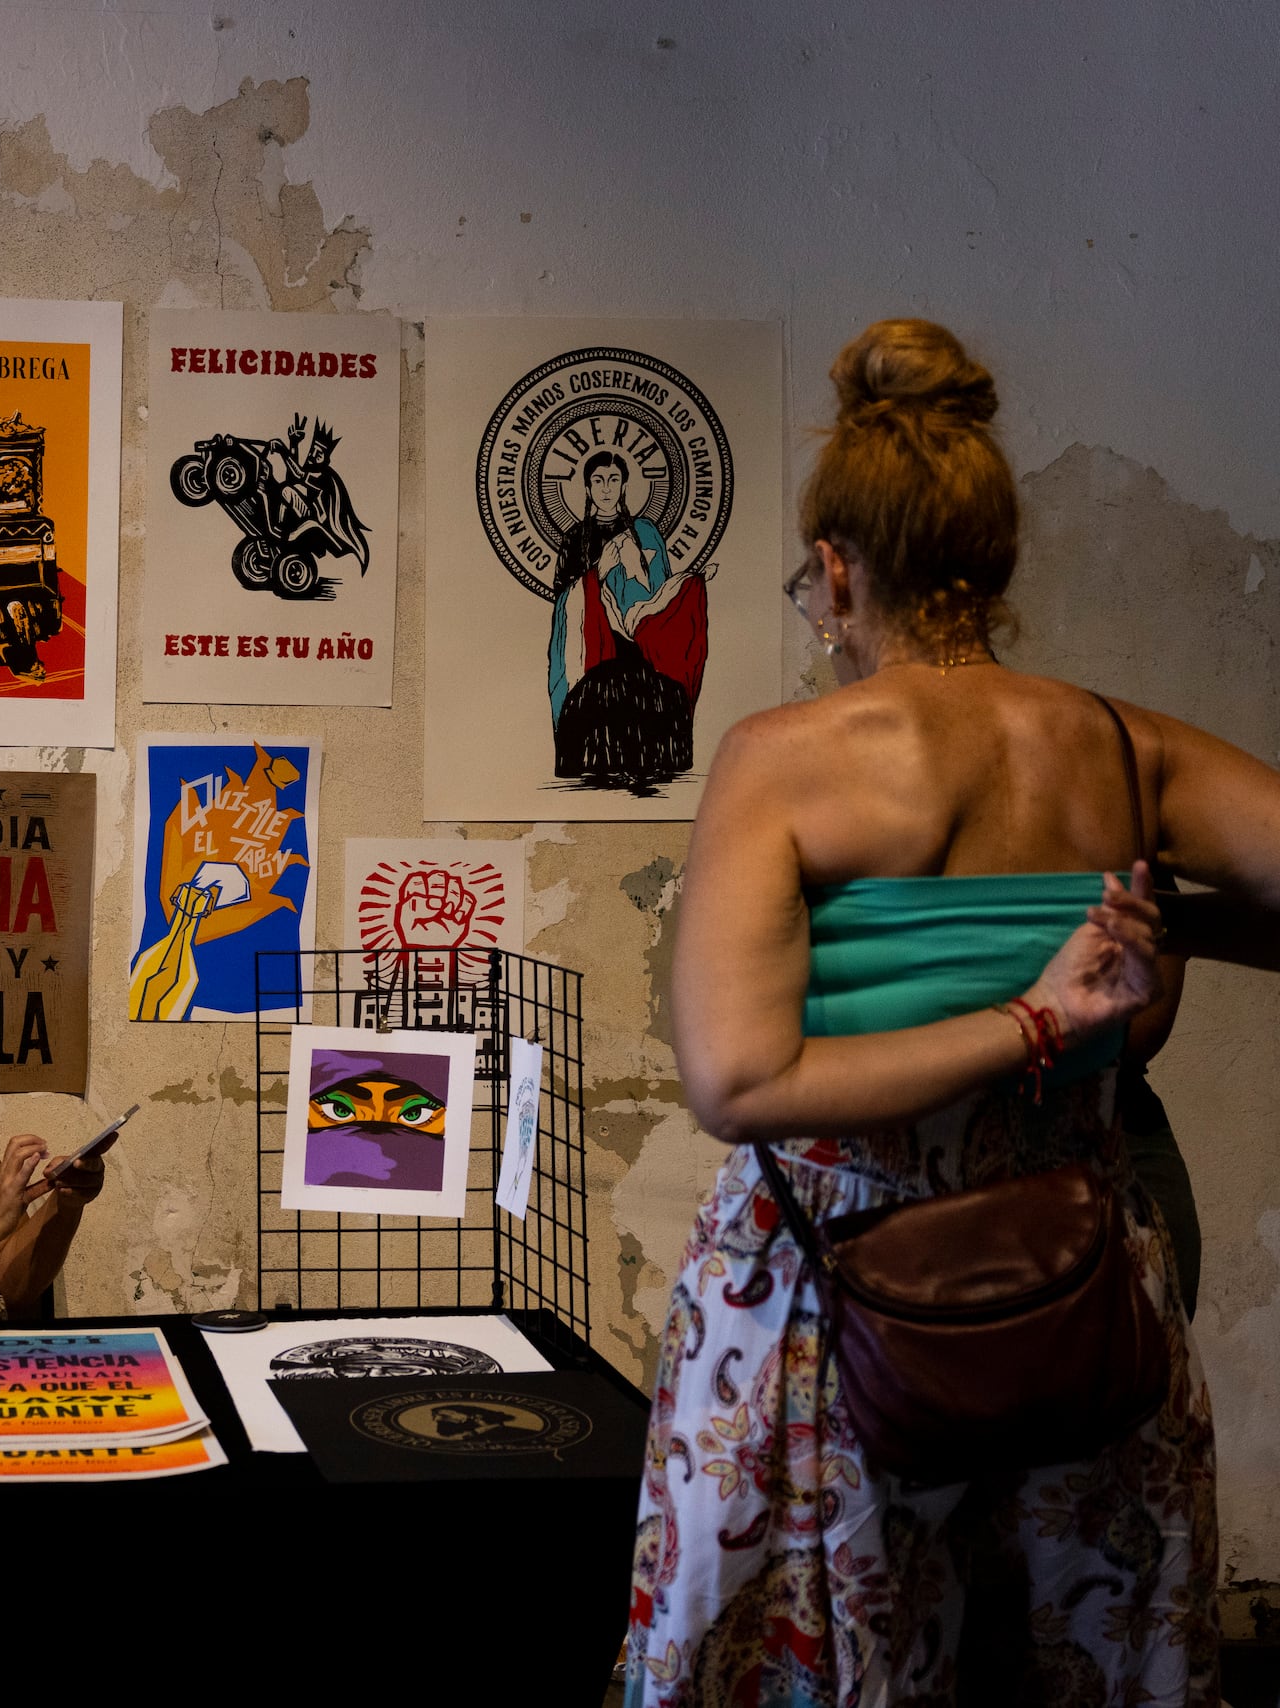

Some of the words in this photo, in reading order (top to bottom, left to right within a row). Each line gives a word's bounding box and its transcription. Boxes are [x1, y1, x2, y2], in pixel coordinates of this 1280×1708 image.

[170, 347, 377, 379] FELICIDADES
[569, 370, 669, 406] COSEREMOS
[512, 382, 565, 436] MANOS
[668, 401, 695, 432] LOS
[545, 417, 667, 481] LIBERTAD
[497, 439, 523, 534] NUESTRAS
[688, 437, 713, 522] CAMINOS
[681, 524, 698, 540] A
[517, 535, 551, 571] CON
[667, 539, 692, 561] LA
[164, 634, 229, 657] ESTE
[237, 635, 269, 658] ES
[275, 636, 310, 658] TU
[316, 632, 374, 661] AÑO
[194, 831, 219, 855] EL
[6, 948, 29, 979] Y
[31, 1371, 133, 1379] DURAR
[40, 1381, 97, 1393] QUE
[108, 1381, 143, 1391] EL
